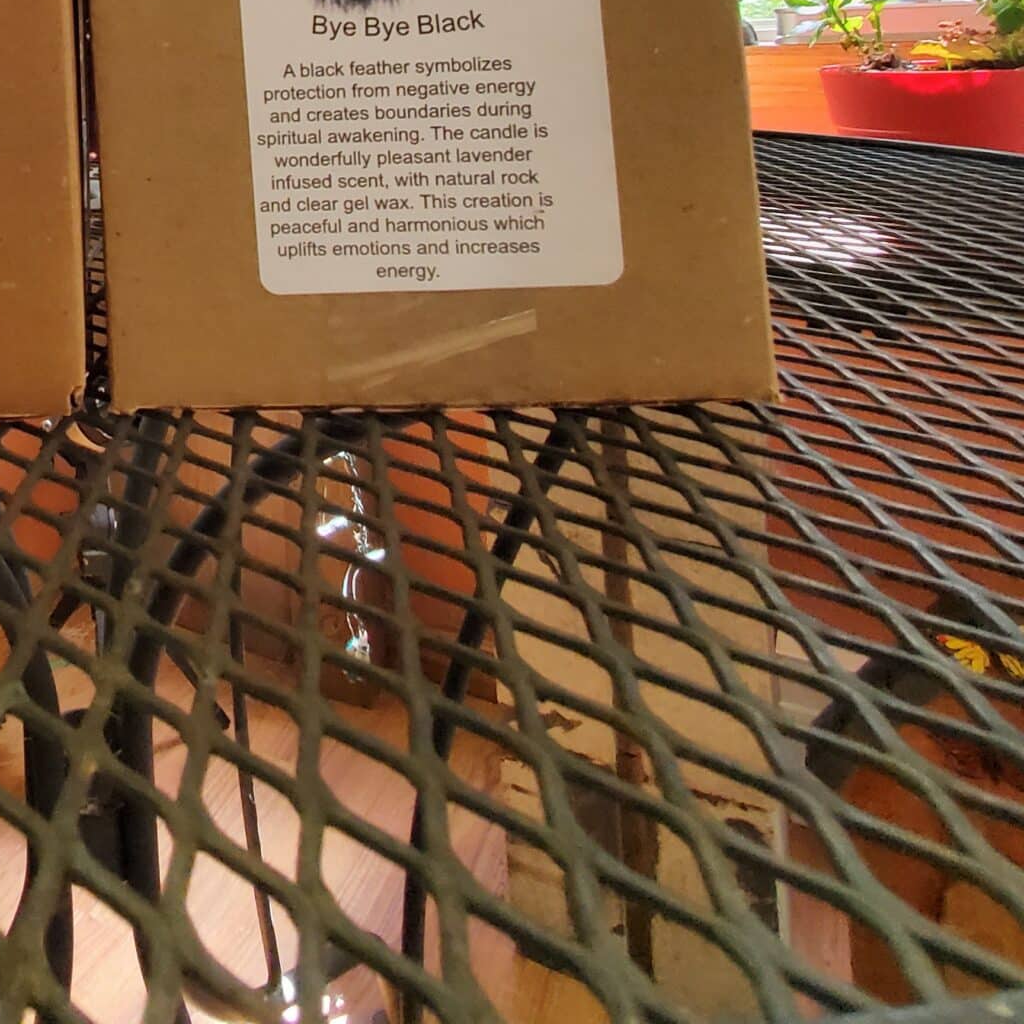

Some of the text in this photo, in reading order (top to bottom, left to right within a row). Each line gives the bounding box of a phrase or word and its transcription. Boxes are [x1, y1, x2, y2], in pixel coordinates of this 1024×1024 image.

[312, 10, 485, 41] Bye Bye Black
[283, 57, 512, 78] A black feather symbolizes
[263, 80, 536, 104] protection from negative energy
[270, 101, 532, 123] and creates boundaries during
[257, 124, 548, 149] spiritual awakening. The candle is
[274, 148, 533, 169] wonderfully pleasant lavender
[271, 170, 539, 190] infused scent, with natural rock
[260, 192, 553, 214] and clear gel wax. This creation is
[271, 215, 545, 238] peaceful and harmonious which
[277, 239, 540, 260] uplifts emotions and increases
[376, 264, 440, 281] energy.
